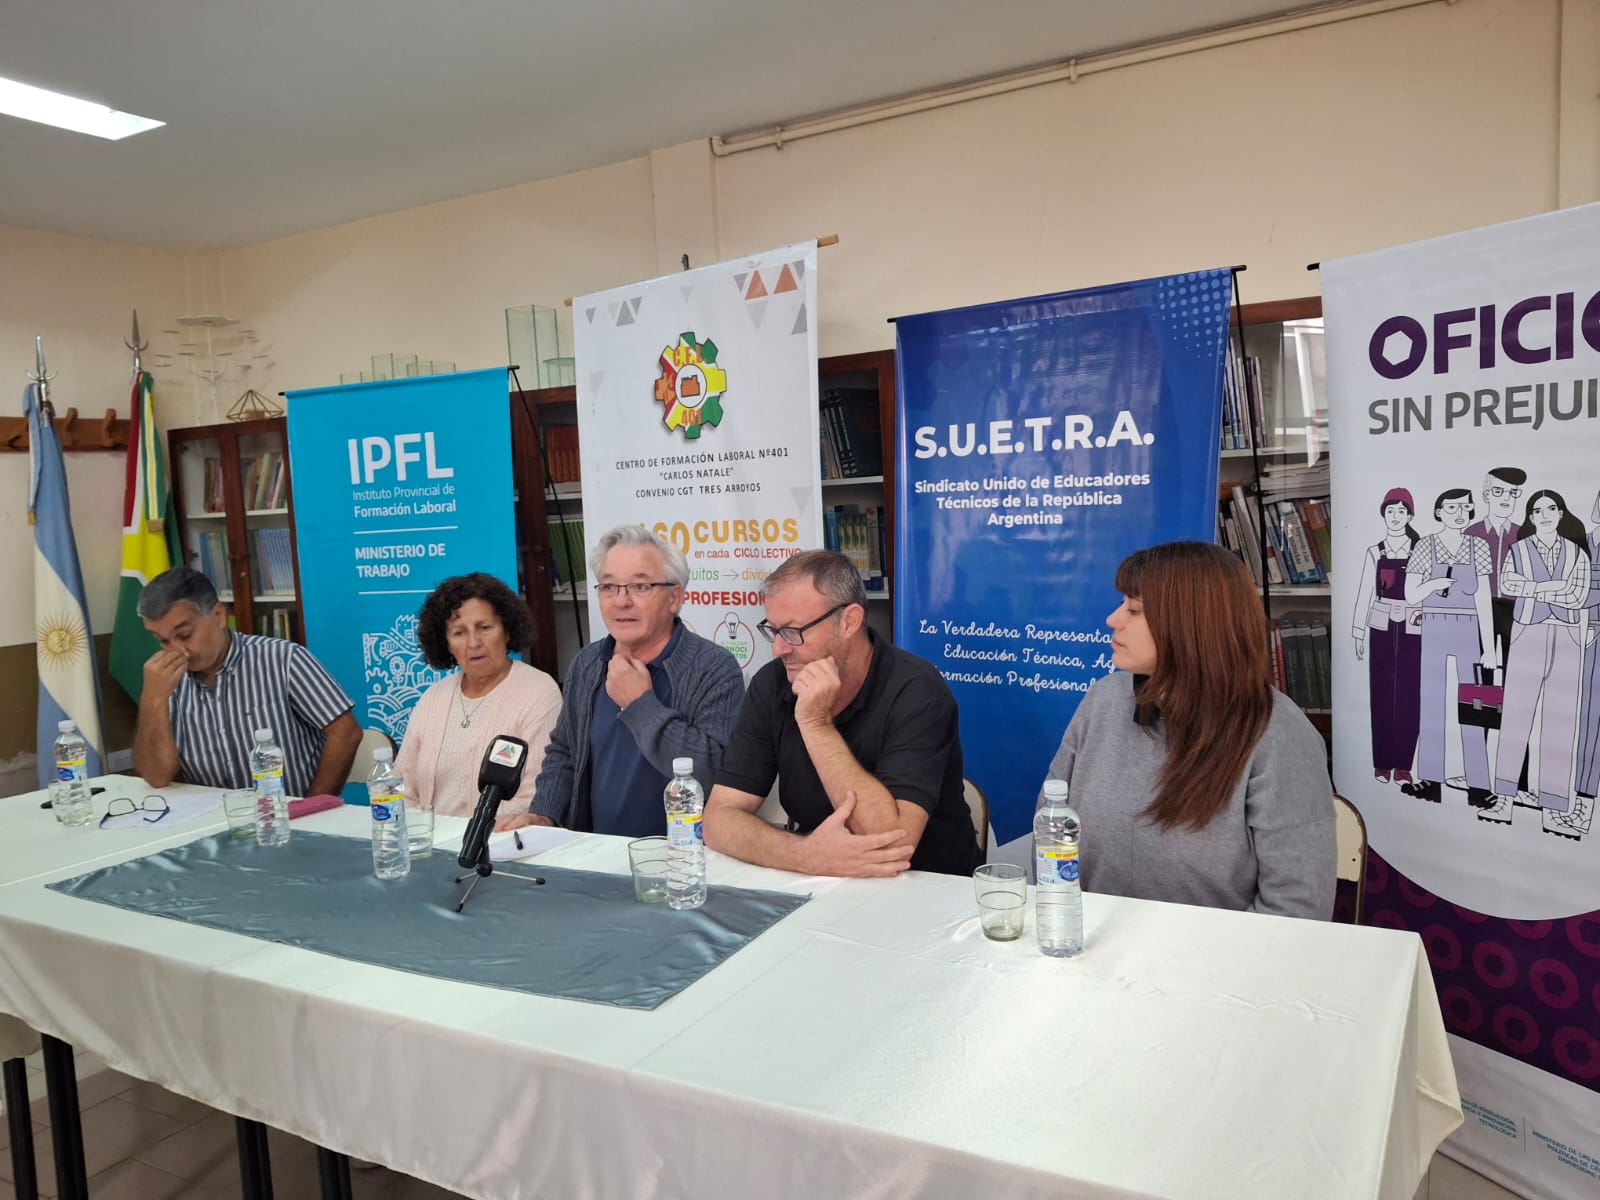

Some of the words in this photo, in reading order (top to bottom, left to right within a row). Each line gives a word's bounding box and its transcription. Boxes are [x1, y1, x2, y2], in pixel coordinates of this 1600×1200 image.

[1369, 395, 1432, 435] SIN
[1445, 378, 1600, 431] PREJUI
[681, 408, 702, 426] 401
[914, 410, 1155, 459] S.U.E.T.R.A.
[348, 432, 454, 484] IPFL
[616, 459, 645, 470] CENTRO
[648, 458, 659, 467] DE
[661, 452, 714, 466] FORMACIÓN
[718, 450, 755, 462] LABORAL
[352, 487, 392, 501] Instituto
[394, 484, 440, 499] Provincial
[442, 482, 455, 495] de
[636, 488, 675, 499] CONVENIO
[677, 486, 694, 496] CGT
[700, 484, 722, 495] TRES
[725, 482, 761, 494] ARROYOS
[915, 480, 979, 493] Sindicato
[983, 477, 1027, 491] Unido
[1031, 475, 1050, 489] de
[1054, 472, 1150, 488] Educadores
[354, 502, 411, 518] Formación
[413, 499, 456, 515] Laboral
[936, 495, 999, 509] Técnicos
[1002, 494, 1021, 508] de
[1025, 493, 1038, 507] la
[1042, 491, 1123, 509] República
[987, 512, 1063, 528] Argentina
[694, 518, 799, 544] CURSOS
[355, 545, 426, 560] MINISTERIO
[428, 543, 446, 557] DE
[694, 550, 706, 559] en
[707, 549, 730, 559] cada
[734, 548, 760, 558] CICLO
[356, 563, 410, 579] TRABAJO
[688, 568, 720, 581] tuitos
[682, 591, 766, 606] PROFESION
[920, 619, 938, 634] La
[941, 620, 1020, 639] Verdadera
[1025, 624, 1113, 644] Representa
[944, 644, 1017, 662] Educación
[1022, 648, 1086, 669] Técnica,
[1091, 653, 1116, 674] Ag
[939, 671, 1003, 685] rmación
[1006, 671, 1096, 694] Profesional
